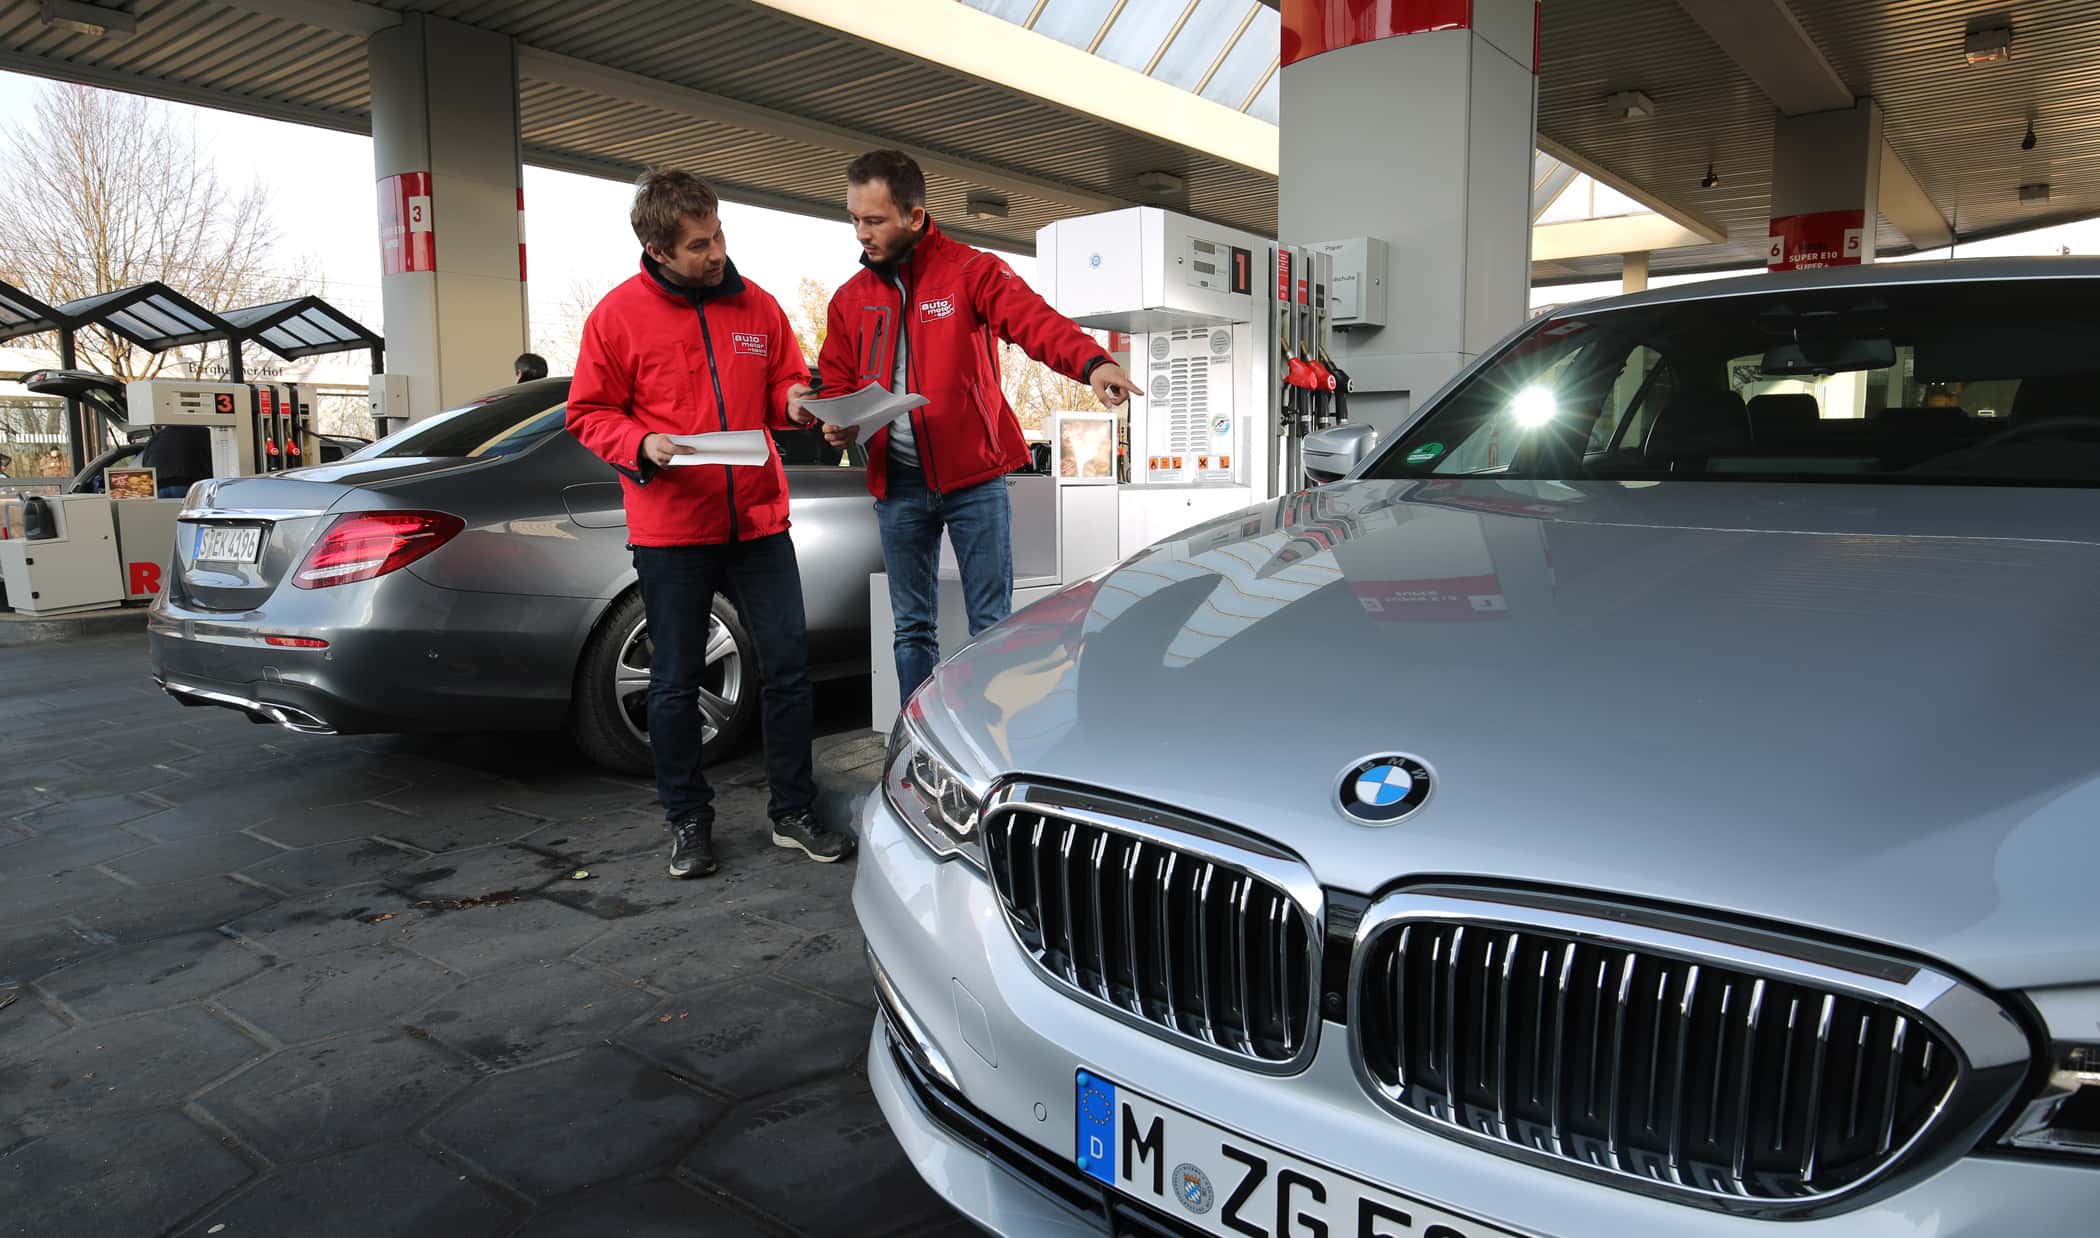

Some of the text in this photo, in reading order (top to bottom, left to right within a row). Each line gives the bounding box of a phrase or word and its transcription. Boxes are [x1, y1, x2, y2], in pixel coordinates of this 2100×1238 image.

[412, 205, 422, 223] 3
[1771, 243, 1780, 257] 6
[1848, 236, 1859, 250] 5
[1789, 251, 1838, 262] SUPER E10
[1236, 252, 1246, 290] 1
[922, 300, 948, 311] auto
[735, 334, 760, 343] auto
[262, 366, 284, 377] Hof
[217, 394, 233, 412] 3
[228, 531, 257, 558] 4196
[129, 562, 161, 595] R
[1359, 757, 1428, 780] BMW
[1090, 1135, 1104, 1160] D
[1122, 1101, 1164, 1196] M
[1221, 1143, 1329, 1238] ZG
